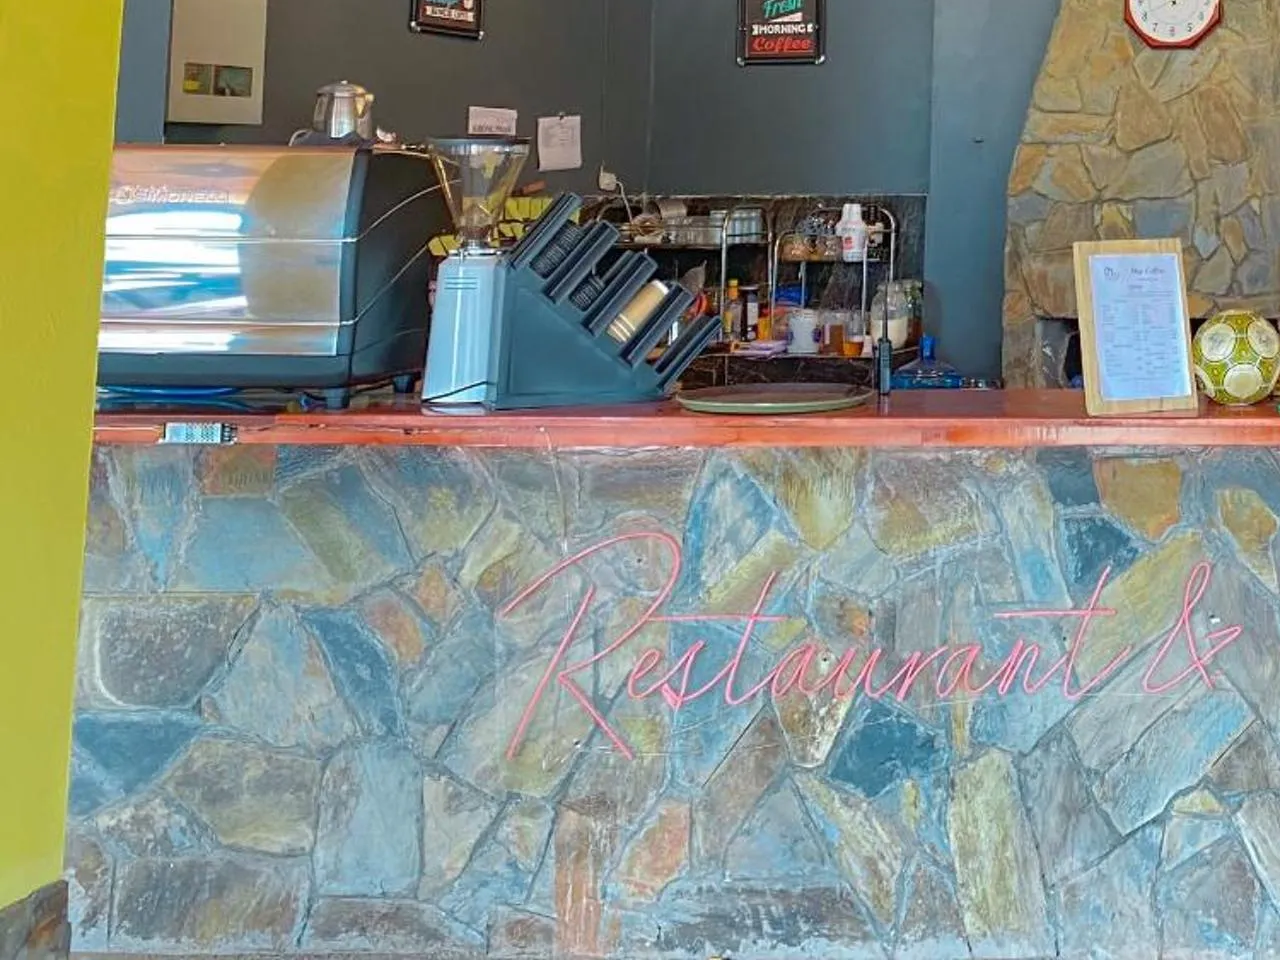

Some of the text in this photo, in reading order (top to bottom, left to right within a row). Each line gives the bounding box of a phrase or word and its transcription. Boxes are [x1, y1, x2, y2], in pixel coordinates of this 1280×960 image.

[759, 23, 806, 35] MORNING
[752, 36, 811, 53] Coffee
[502, 531, 1133, 760] Restaurant
[1143, 561, 1244, 693] &
